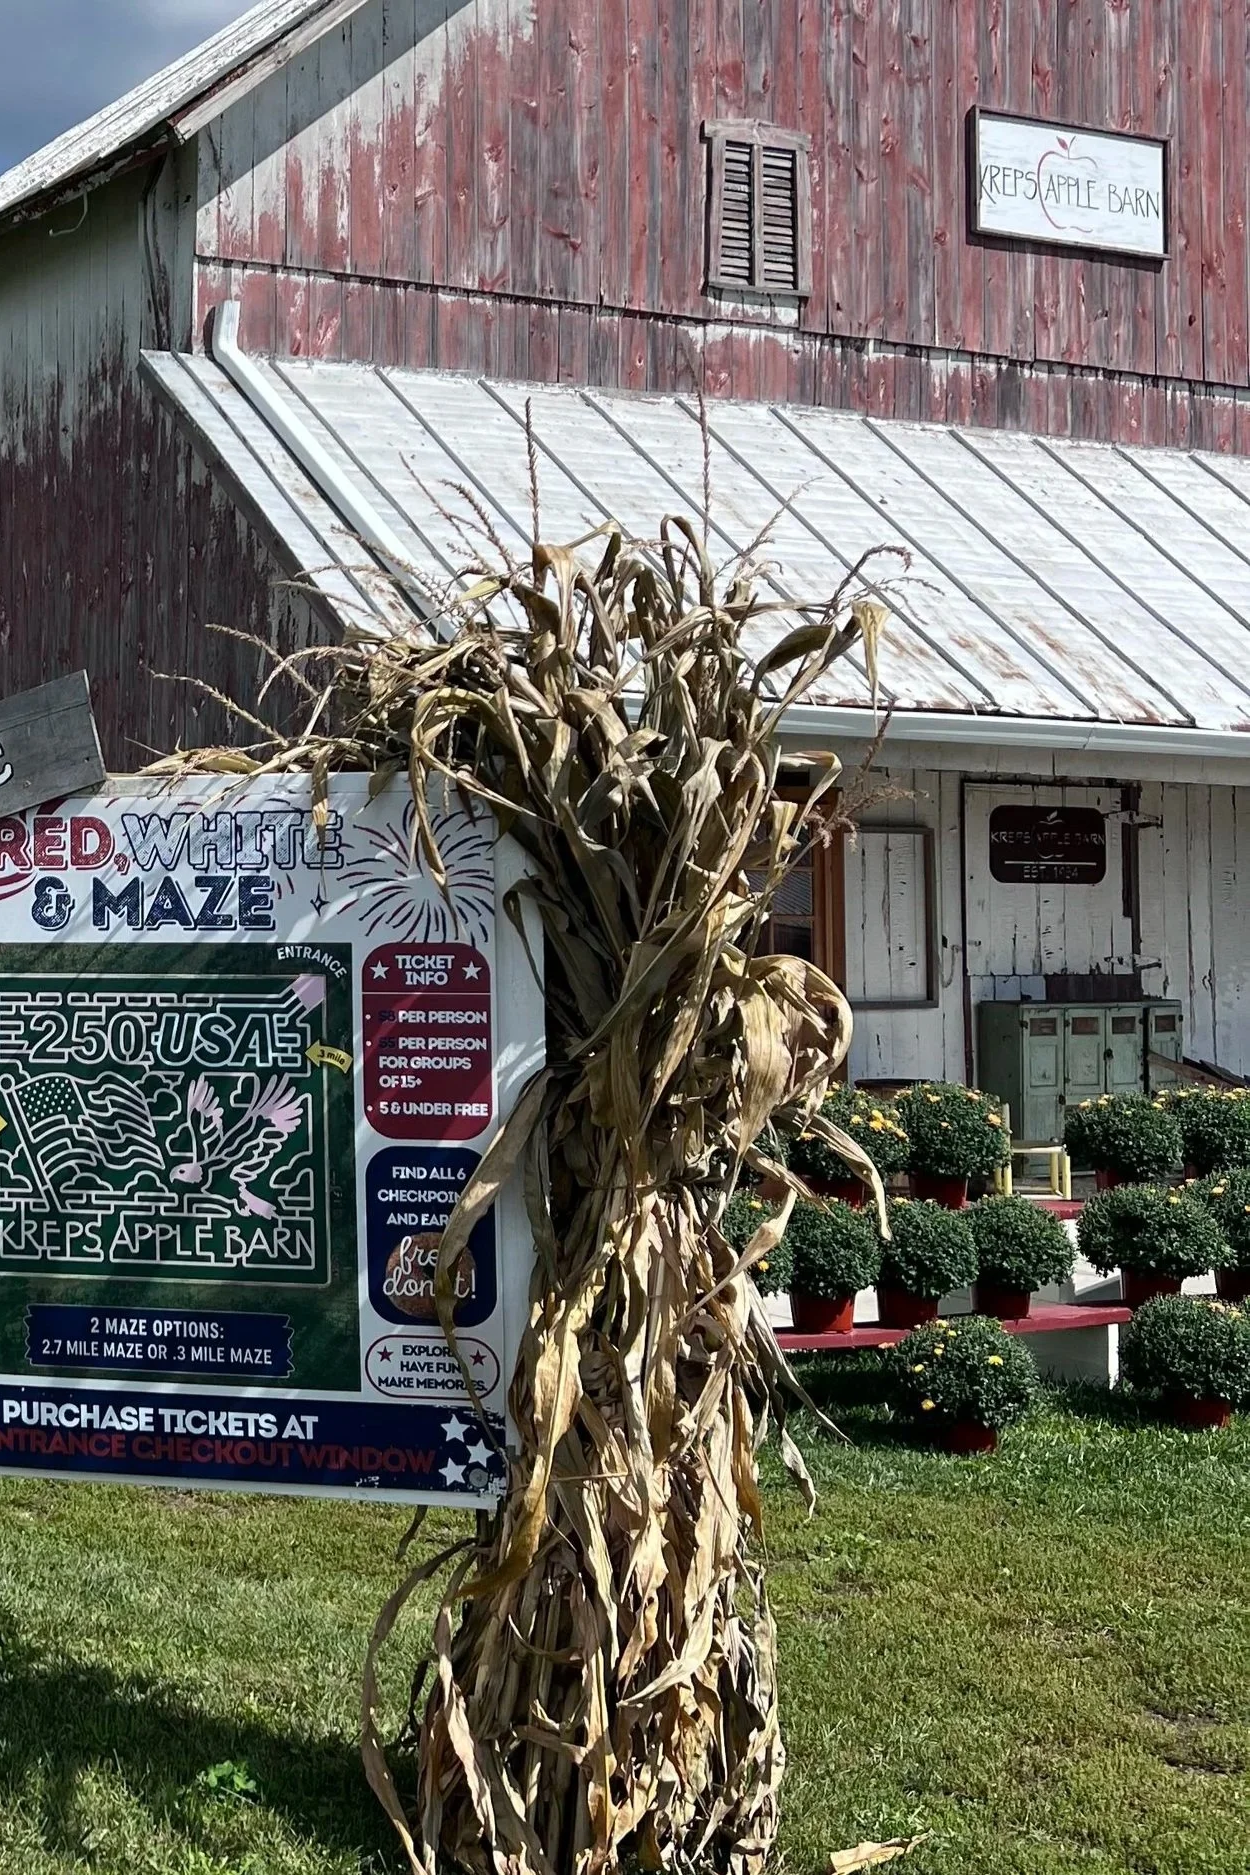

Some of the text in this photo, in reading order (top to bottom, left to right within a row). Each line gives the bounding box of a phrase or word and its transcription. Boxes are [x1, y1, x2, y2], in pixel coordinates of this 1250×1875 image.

[980, 164, 1160, 219] KREPS APPLE BARN
[121, 810, 345, 871] WHITE
[990, 831, 1031, 844] KREPS
[31, 874, 276, 932] & MAZE
[276, 945, 348, 979] ENTRANCE
[395, 954, 456, 970] TICKET
[405, 971, 449, 986] INFO
[399, 1010, 426, 1024] PER
[428, 1010, 487, 1024] PERSON
[29, 1011, 272, 1067] 250 USA
[399, 1037, 426, 1050] PER
[428, 1037, 487, 1051] PERSON
[327, 1051, 346, 1066] mile
[379, 1056, 472, 1070] FOR GROUPS
[379, 1075, 423, 1088] OF 15+
[379, 1101, 489, 1117] 5 & UNDER FREE
[392, 1165, 467, 1181] FIND ALL 6
[377, 1189, 463, 1204] CHECKPOIN
[386, 1212, 451, 1227] AND EAR
[0, 1219, 314, 1260] KREPS APPLE BARN
[400, 1235, 440, 1276] fre
[383, 1265, 477, 1299] dont!
[90, 1316, 225, 1340] 2 MAZE OPTIONS:
[42, 1338, 273, 1365] 2.7 MILE MAZE OR .3 MILE MAZE
[402, 1344, 454, 1358] EXPLOR
[400, 1360, 434, 1373] HAVE
[378, 1376, 415, 1389] MAKE
[2, 1399, 319, 1440] PURCHASE TICKETS AT
[131, 1434, 294, 1469] CHECKOUT
[299, 1443, 439, 1474] WINDOW
